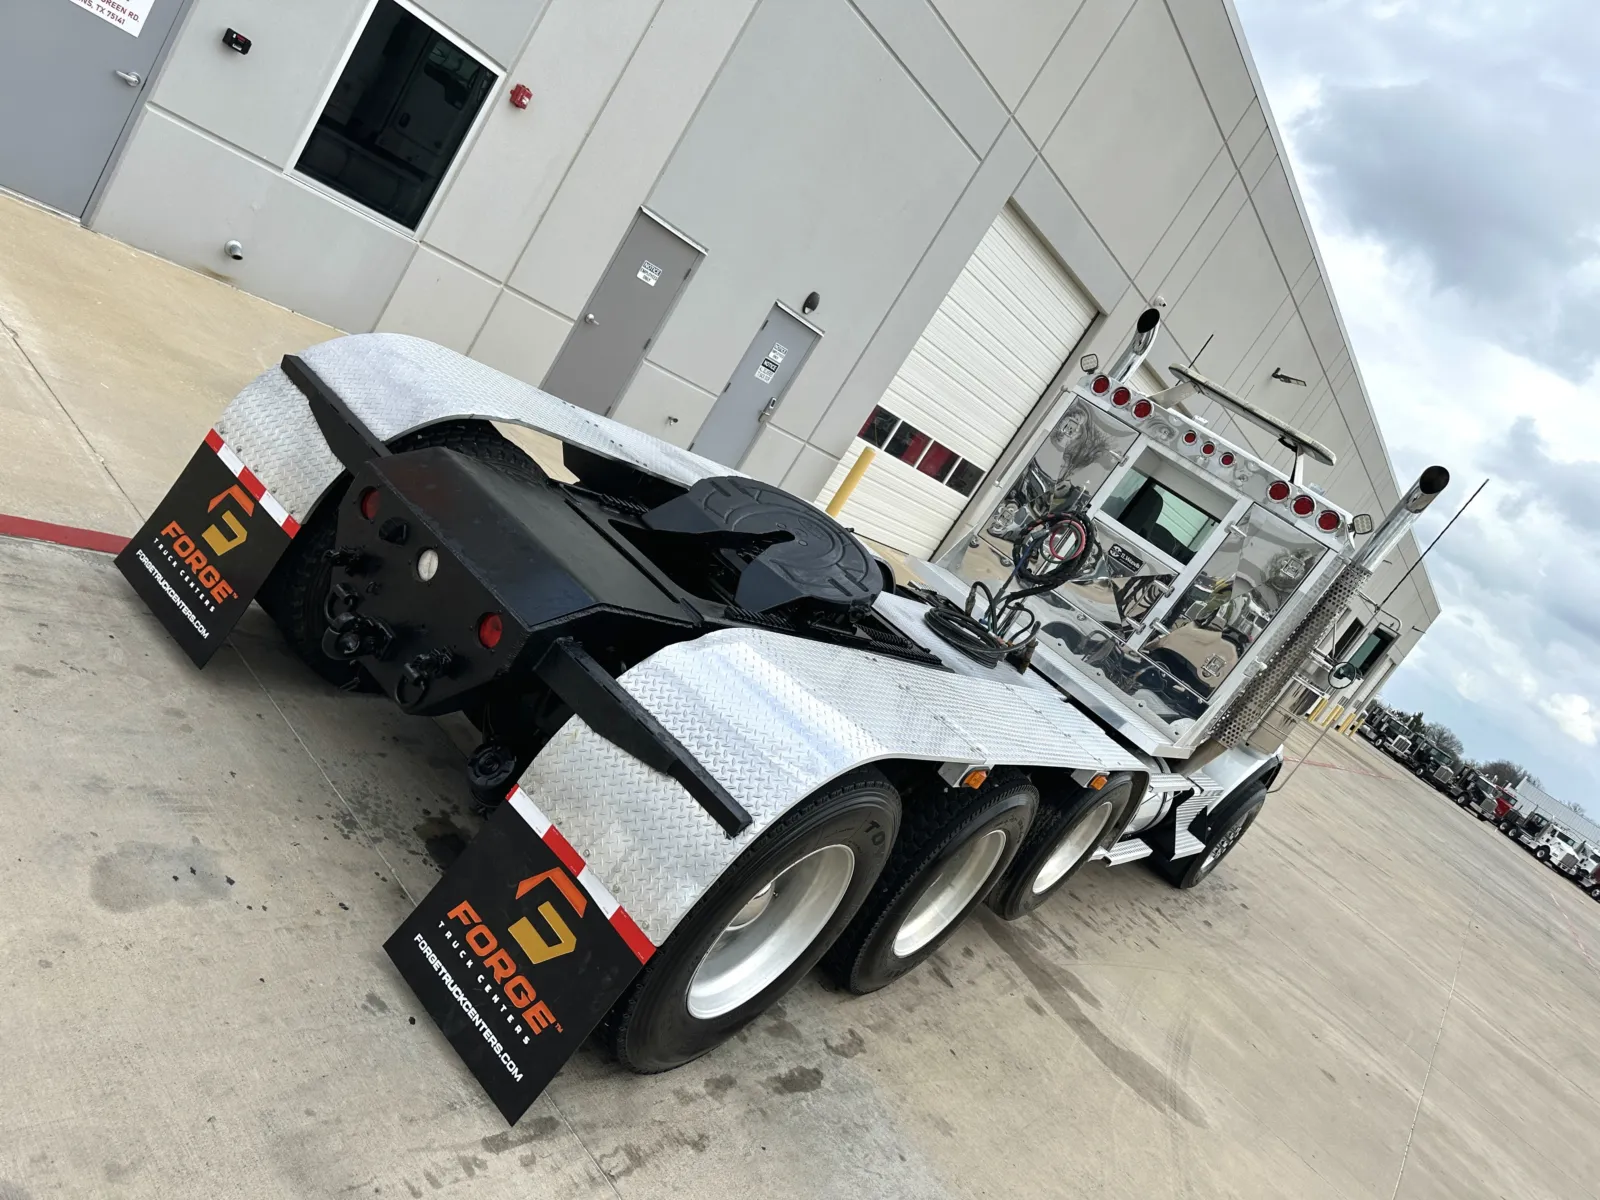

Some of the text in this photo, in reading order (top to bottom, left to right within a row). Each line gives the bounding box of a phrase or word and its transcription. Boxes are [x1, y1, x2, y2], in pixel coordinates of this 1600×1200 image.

[96, 4, 105, 14] TX
[107, 10, 126, 25] 75141
[128, 11, 139, 22] RD.
[642, 261, 661, 276] NOTICE
[135, 549, 210, 640] FORGETRUCKCENTERS.COM
[154, 538, 215, 613] TRUCK CENTERS
[160, 520, 234, 605] FORGE
[413, 933, 524, 1083] FORGETRUCKCENTERS.COM
[438, 920, 531, 1045] TRUCK CENTERS
[447, 900, 557, 1036] FORGE
